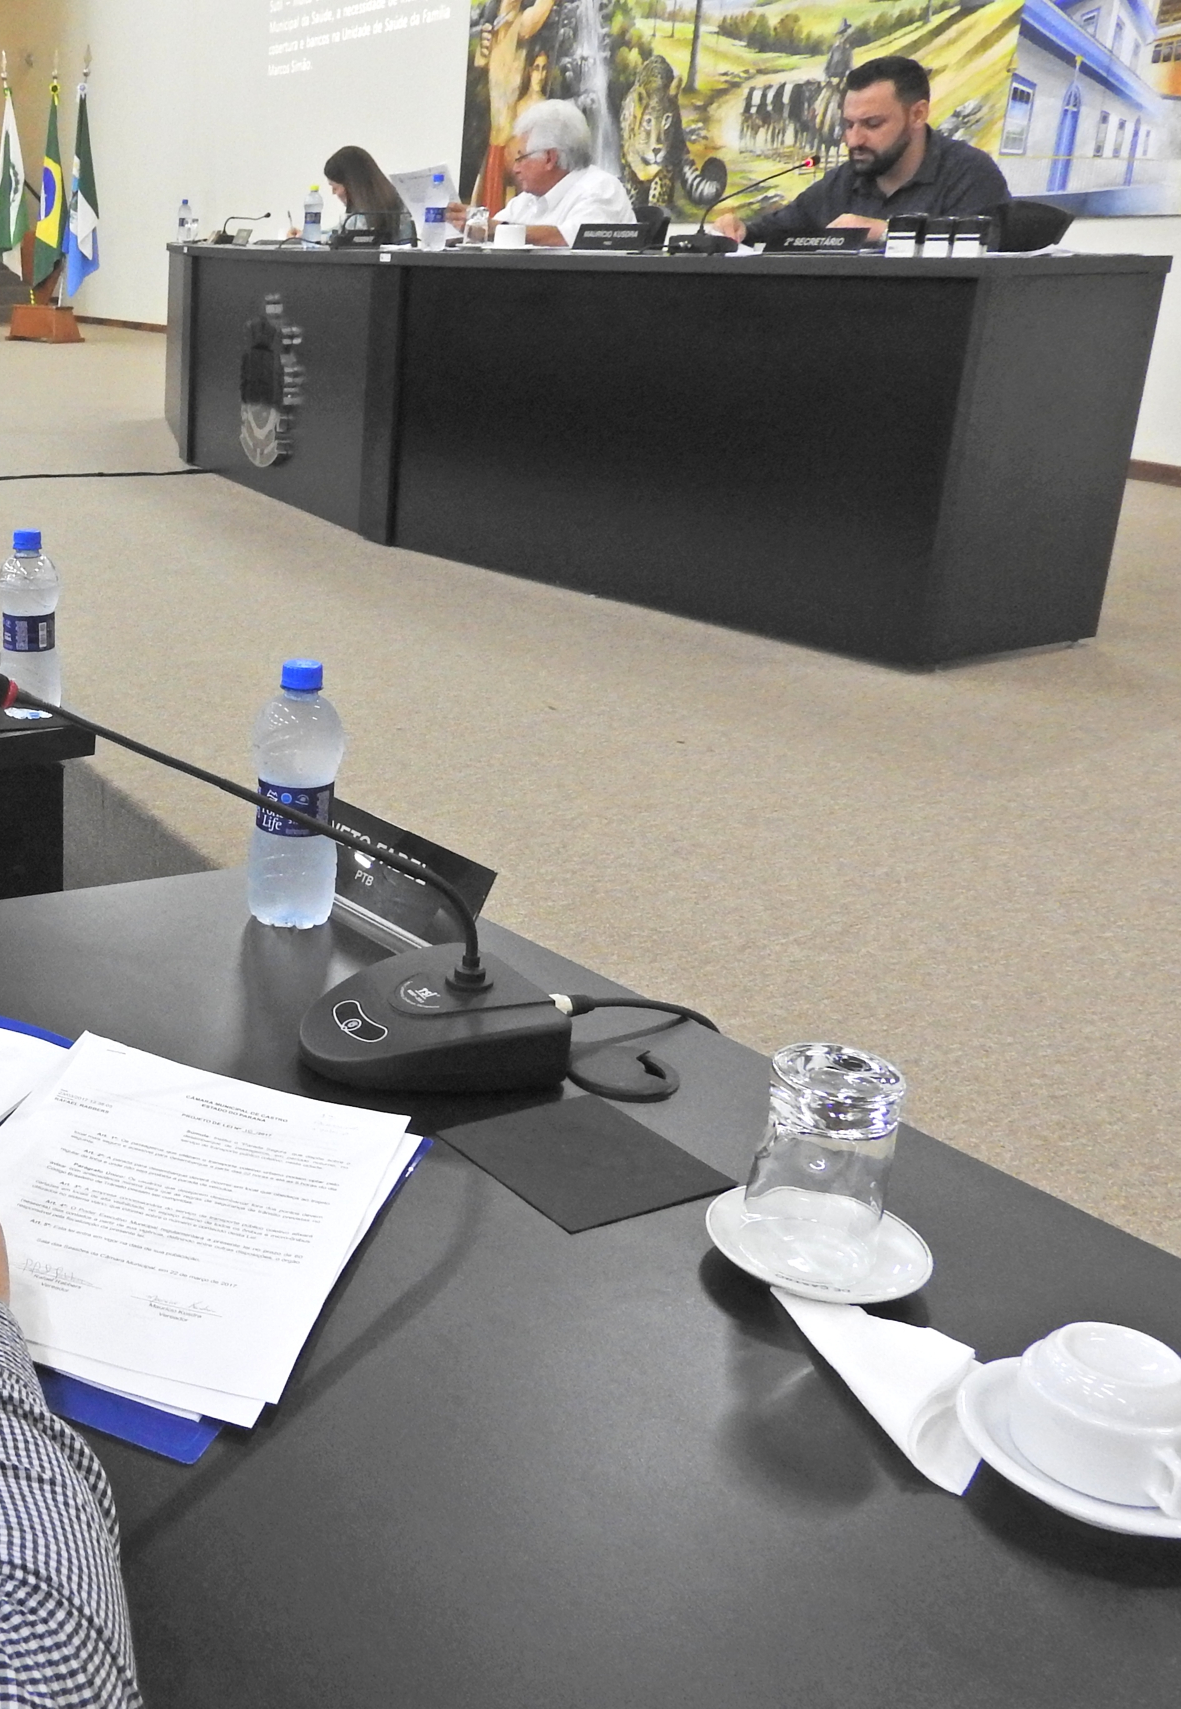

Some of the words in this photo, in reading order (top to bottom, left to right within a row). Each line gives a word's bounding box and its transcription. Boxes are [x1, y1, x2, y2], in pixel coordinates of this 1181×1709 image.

[342, 23, 371, 41] Unidade
[793, 236, 846, 246] SECRETÁRIO
[262, 814, 283, 832] Life
[354, 869, 374, 887] PTB
[201, 1103, 227, 1112] ESTADO
[215, 1102, 248, 1112] MUNICIPAL
